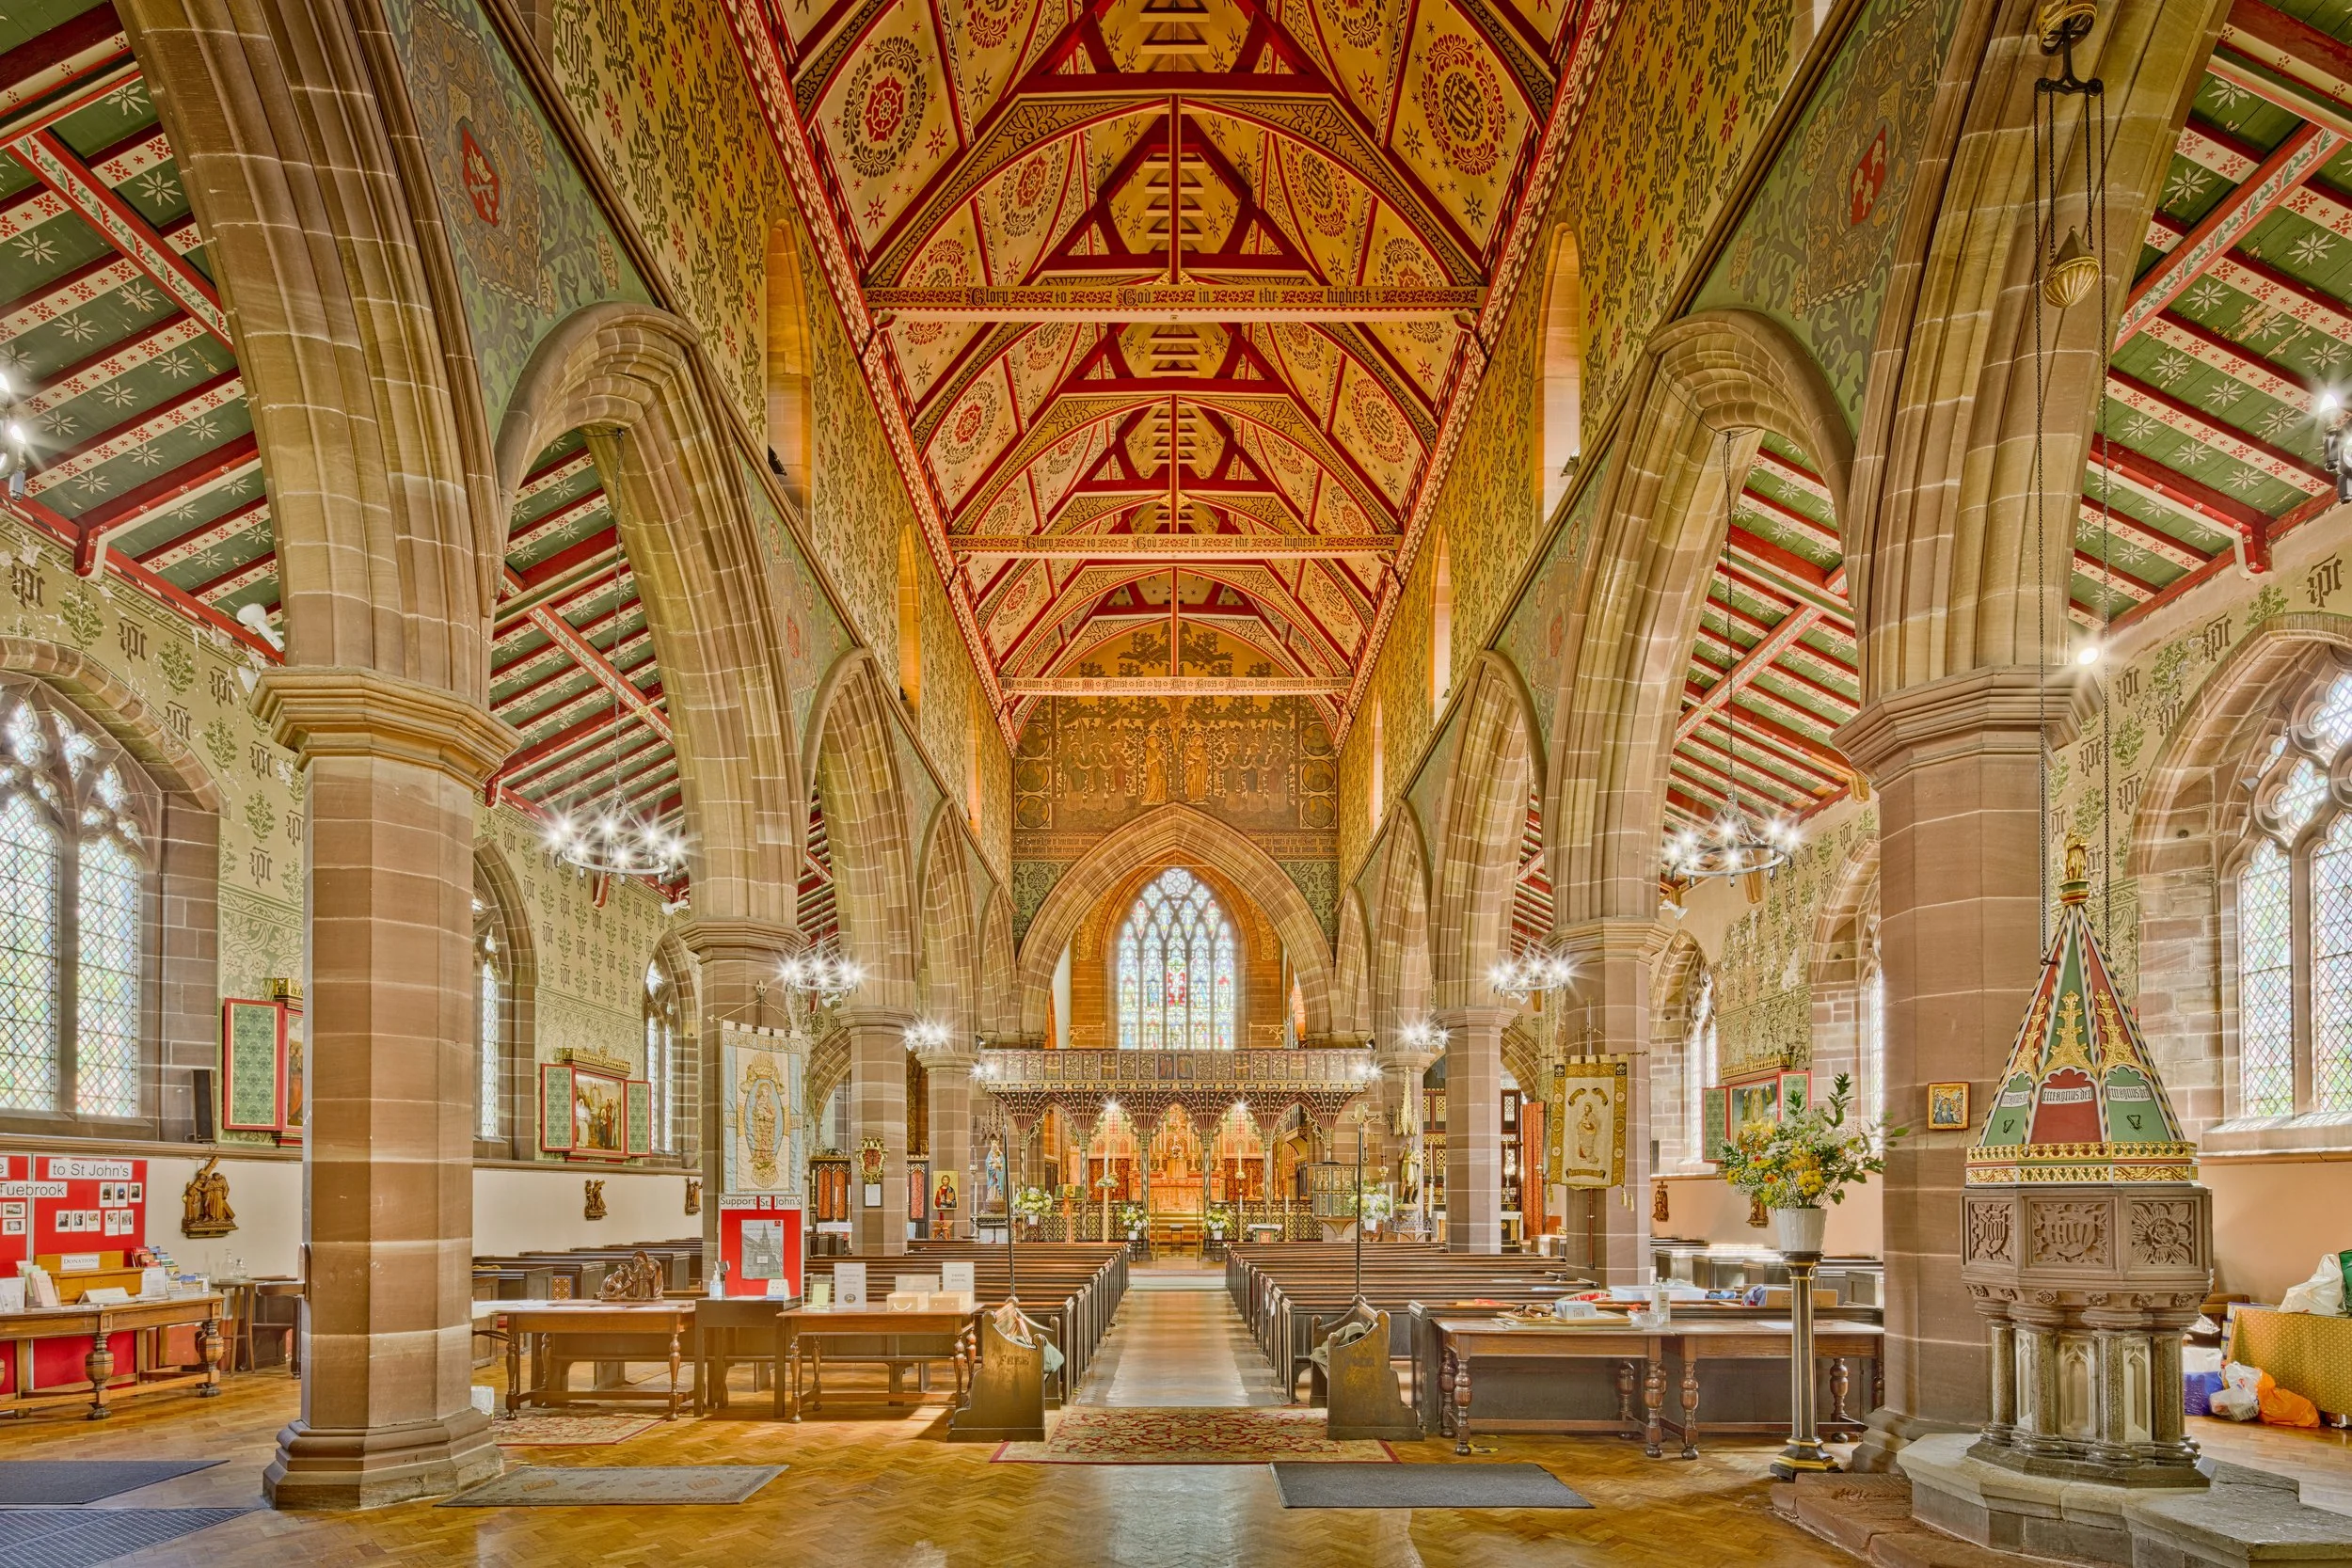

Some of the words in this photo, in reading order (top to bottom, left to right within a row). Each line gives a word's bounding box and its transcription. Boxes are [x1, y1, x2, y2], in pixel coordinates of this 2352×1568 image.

[969, 287, 1009, 307] Glory
[1056, 290, 1067, 303] to
[1122, 289, 1152, 307] God
[1199, 288, 1210, 303] in
[1259, 288, 1278, 303] the
[1025, 536, 1054, 550] Glory
[1088, 538, 1096, 547] to
[1136, 536, 1157, 550] God
[1191, 535, 1200, 547] in
[1235, 536, 1249, 547] the
[1024, 678, 1042, 688] adore
[1104, 678, 1127, 689] Christ
[1153, 679, 1162, 689] by
[1196, 678, 1216, 689] Cross
[1255, 678, 1268, 688] hast
[1276, 678, 1305, 688] redeemed
[1313, 678, 1323, 687] the
[53, 1164, 66, 1175] to
[71, 1164, 85, 1176] St
[88, 1164, 129, 1177] John's
[0, 1182, 65, 1196] Tuebrook
[720, 1196, 756, 1208] Support
[775, 1196, 802, 1208] John's
